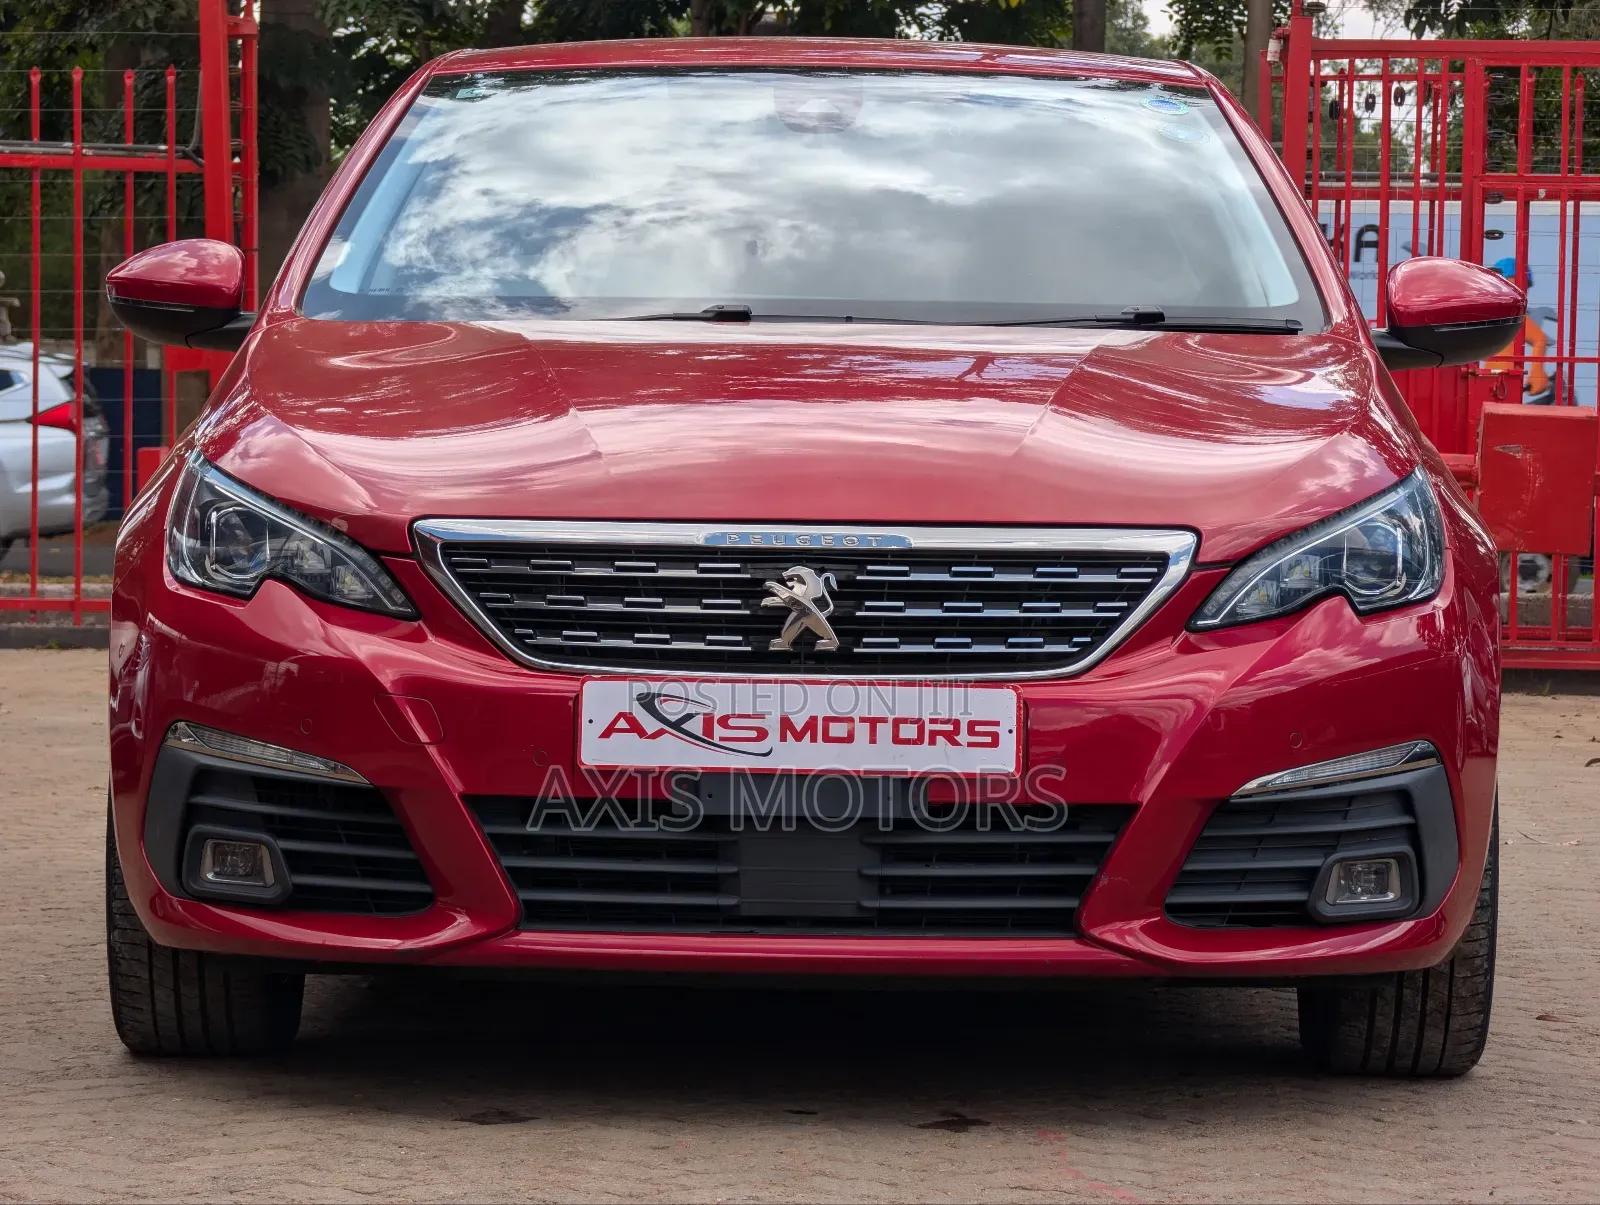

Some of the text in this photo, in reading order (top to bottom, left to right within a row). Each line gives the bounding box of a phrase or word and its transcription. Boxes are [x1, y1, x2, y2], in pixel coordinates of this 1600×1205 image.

[726, 532, 882, 547] PEUGEOT
[598, 697, 1001, 755] AXIS MOTORS
